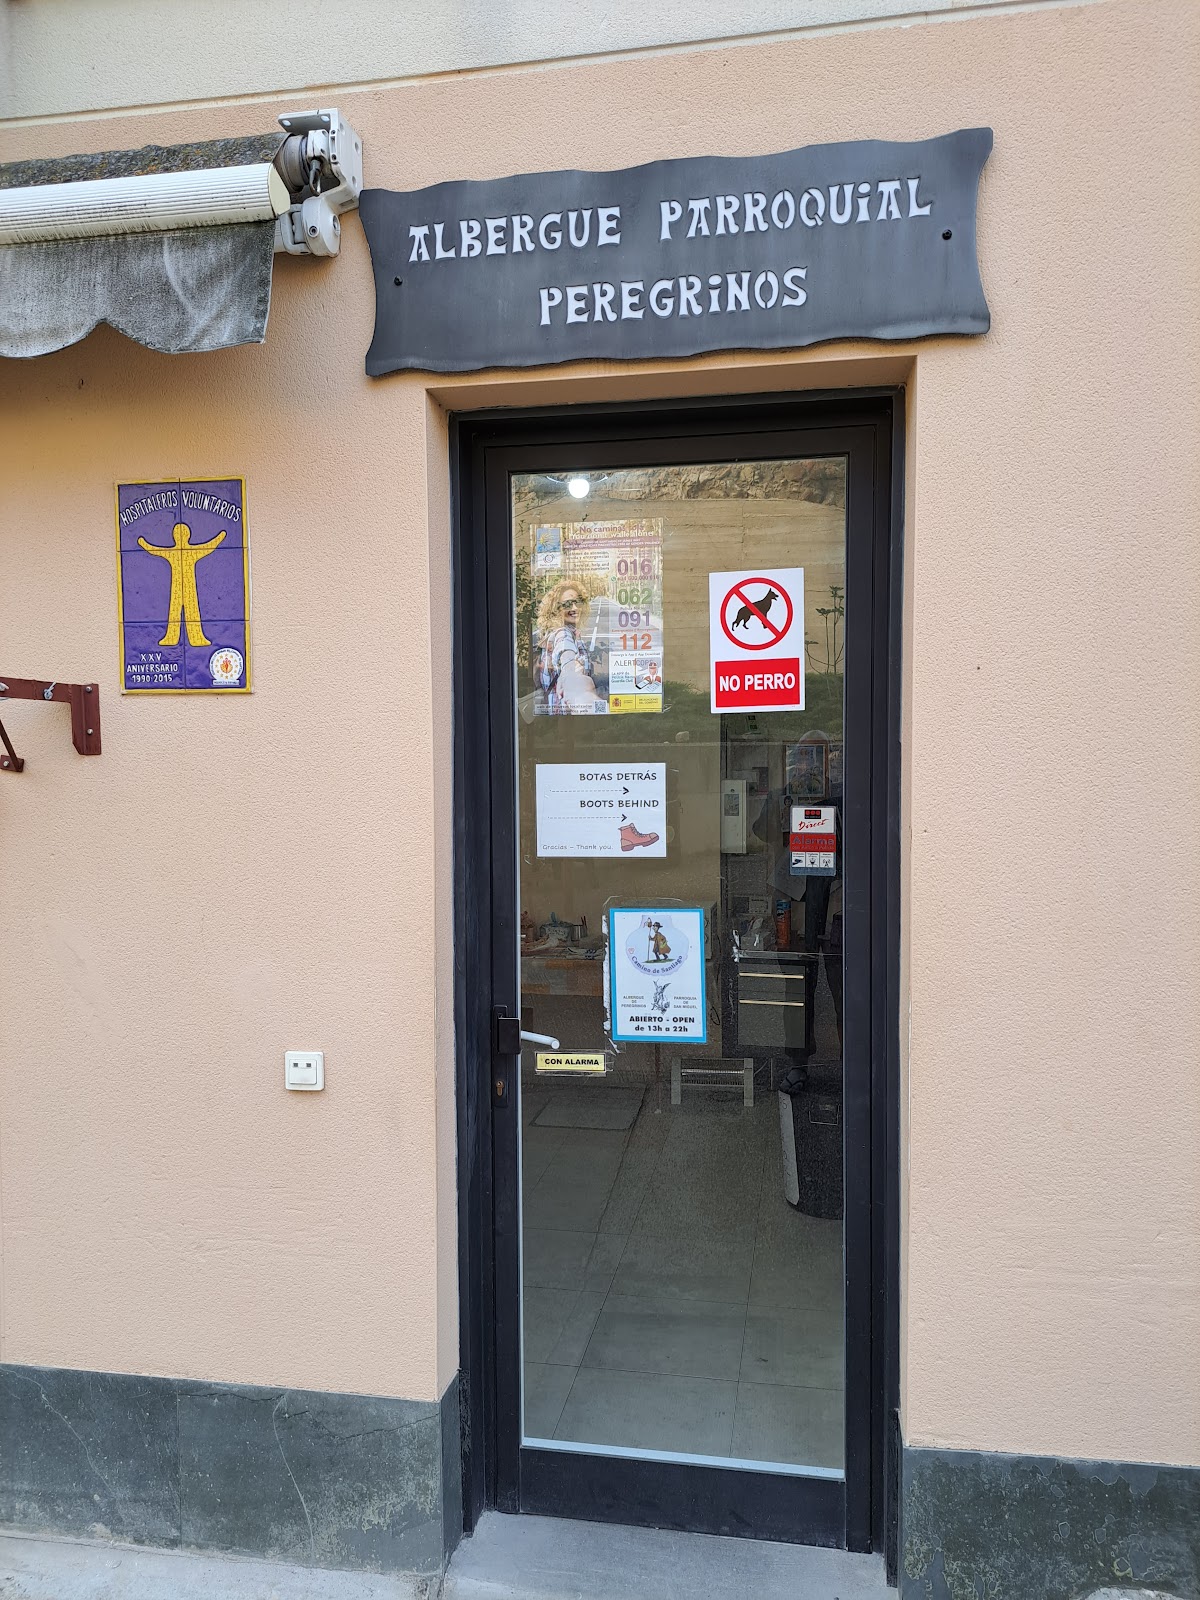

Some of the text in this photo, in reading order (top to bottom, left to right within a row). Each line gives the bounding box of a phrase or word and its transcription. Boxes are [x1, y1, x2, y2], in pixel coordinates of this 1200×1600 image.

[408, 205, 622, 263] ALBERGUE
[120, 490, 241, 526] HOSPITALEROS VOLUNTARIOS
[579, 525, 592, 534] No
[617, 558, 652, 576] 016
[617, 587, 653, 606] 062
[618, 610, 650, 628] 091
[619, 632, 652, 650] 112
[140, 652, 162, 662] XXV
[126, 663, 178, 673] ANIVERSARIO
[719, 672, 796, 692] NO PERRO
[579, 770, 657, 781] BOTAS DETRÁS
[580, 800, 659, 808] BOOTS BEHIND
[791, 835, 835, 846] Alarma
[631, 955, 651, 973] Camino
[661, 955, 683, 973] Santiago
[629, 1015, 664, 1023] ABIERTO
[672, 1016, 695, 1024] OPEN
[564, 1058, 600, 1066] ALARMA
